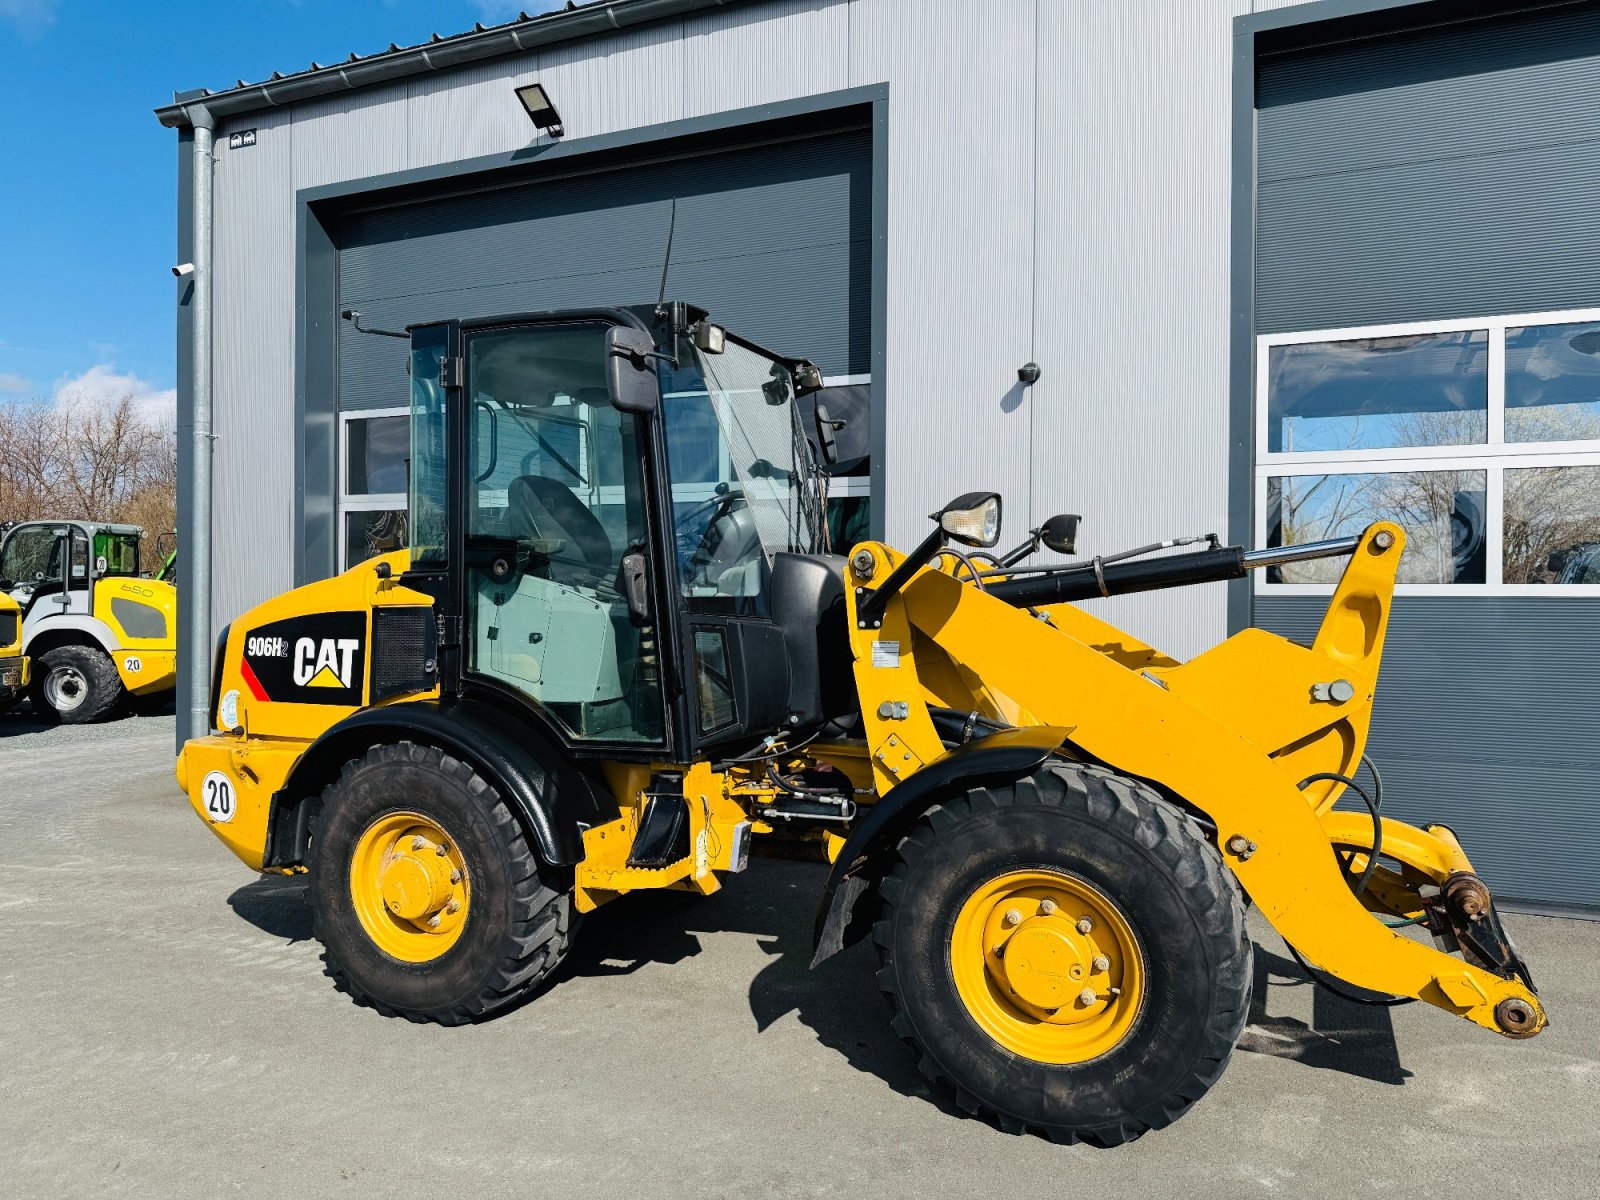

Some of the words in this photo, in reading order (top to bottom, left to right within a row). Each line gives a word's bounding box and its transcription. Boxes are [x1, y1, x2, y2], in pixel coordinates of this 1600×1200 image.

[121, 584, 154, 598] 650
[126, 659, 140, 671] 20
[293, 637, 359, 689] CAT
[208, 779, 230, 814] 20
